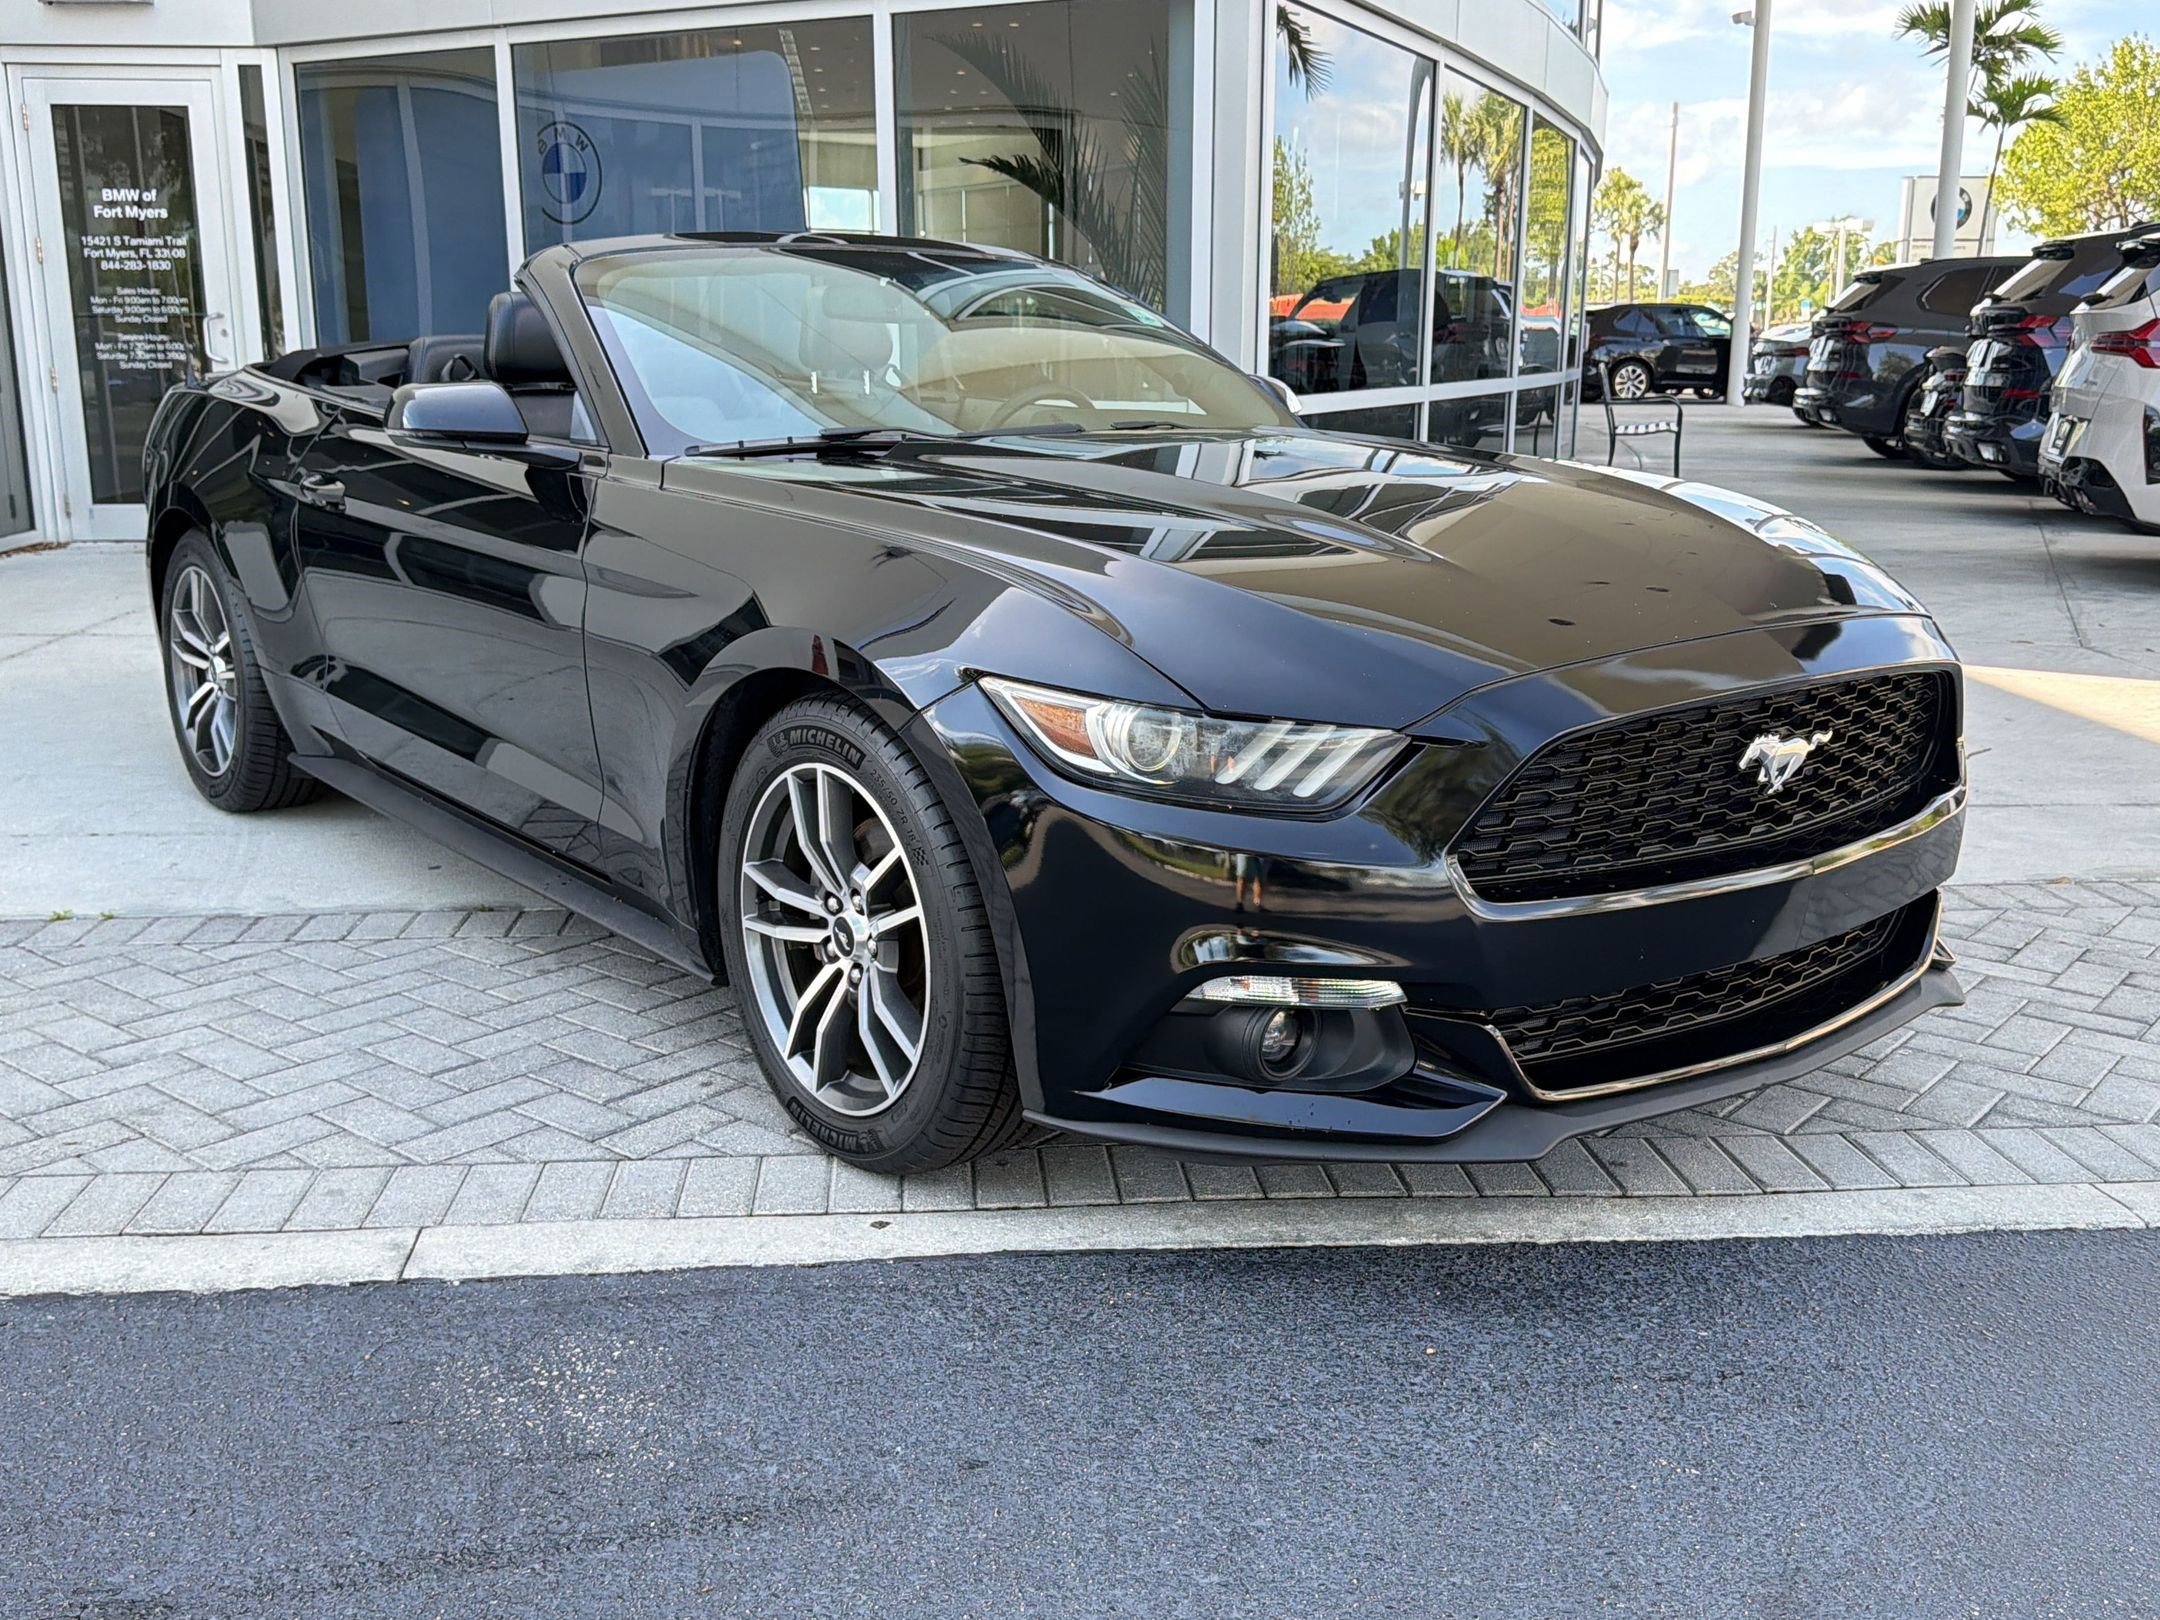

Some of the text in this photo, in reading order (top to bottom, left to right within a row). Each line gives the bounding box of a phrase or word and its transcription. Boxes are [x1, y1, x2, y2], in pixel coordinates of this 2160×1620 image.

[101, 188, 157, 202] BMW of
[93, 205, 169, 221] Fort Myers
[81, 235, 187, 246] 15421 S Tamiami Trail
[83, 248, 104, 258] Fort
[105, 248, 138, 260] Myers,
[139, 248, 153, 258] FL
[90, 296, 108, 304] Mon
[113, 296, 123, 304] Fri
[152, 296, 160, 304] to
[92, 305, 123, 314] Saturday
[152, 305, 160, 313] to
[115, 315, 168, 324] Sunday Closed
[95, 342, 113, 351] Mon
[156, 342, 165, 351] to
[96, 351, 128, 361] Saturday
[157, 351, 165, 360] to
[119, 361, 146, 370] Sunday
[789, 727, 861, 765] MICHELIN
[870, 768, 898, 807] 235/50
[788, 1099, 858, 1152] MICHELIN
